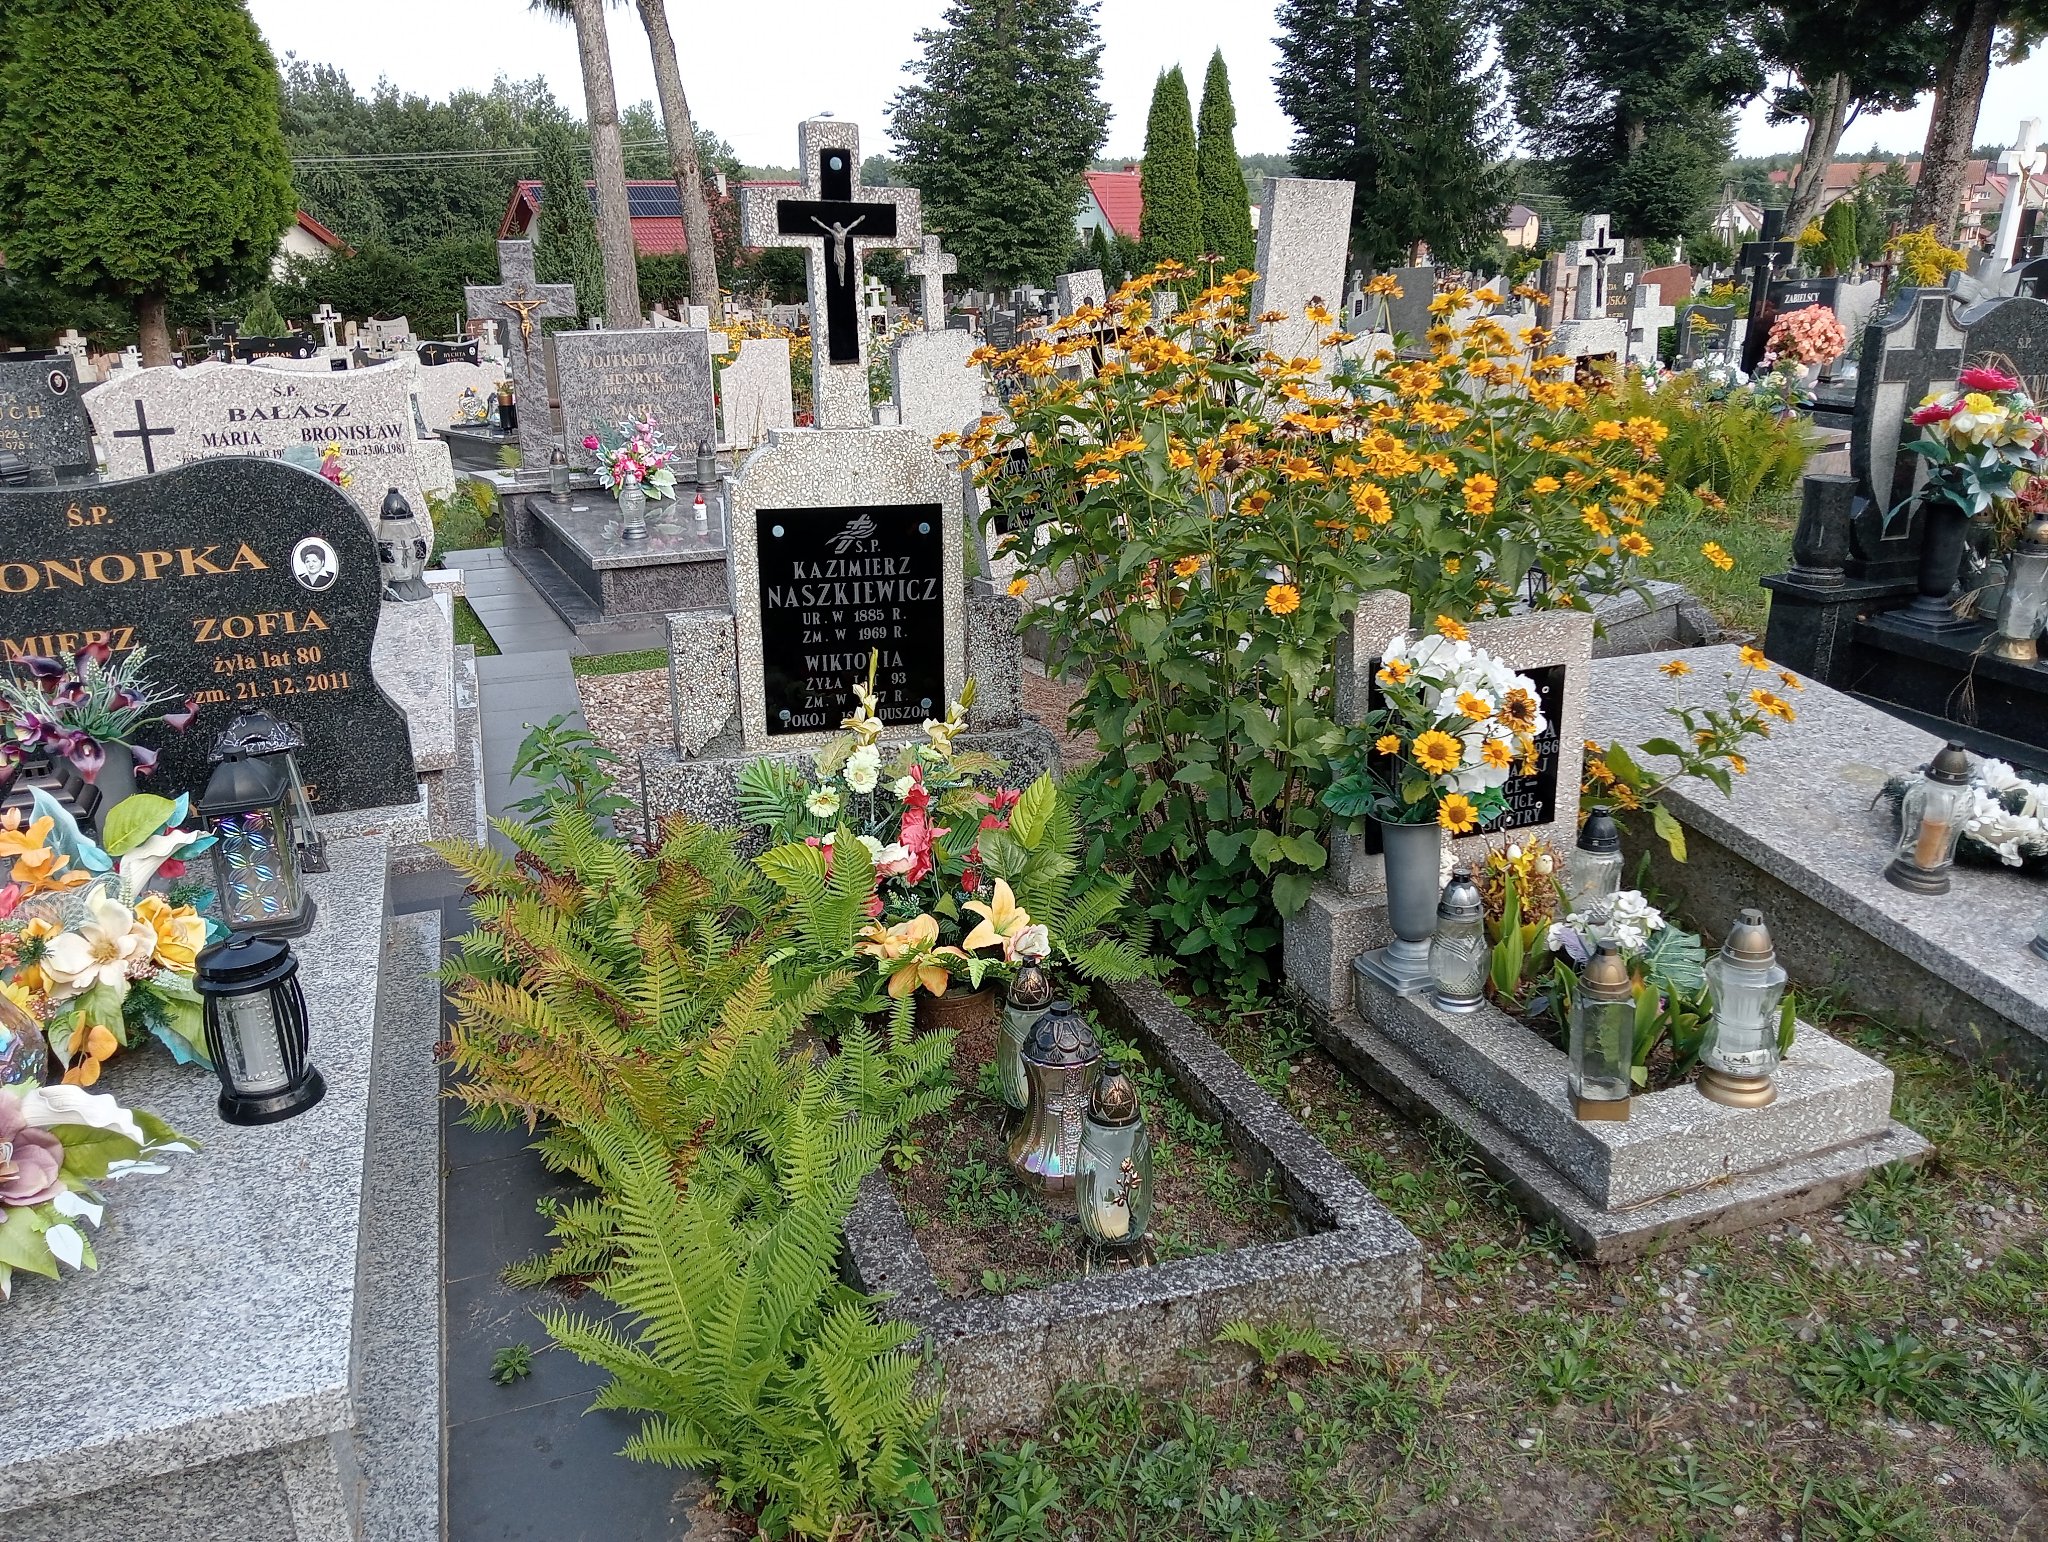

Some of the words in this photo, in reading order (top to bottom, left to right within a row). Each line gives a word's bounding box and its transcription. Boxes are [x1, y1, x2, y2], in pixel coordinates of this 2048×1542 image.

[1784, 292, 1820, 303] ZABIELSCY
[604, 372, 666, 385] HENRYK
[228, 403, 351, 422] BAŁASZ
[201, 431, 263, 448] MARIA
[301, 424, 402, 442] BRONISŁAW
[68, 502, 114, 527] Ś.P.
[793, 556, 911, 580] KAZIMIERZ
[767, 577, 938, 609] NASZKIEWICZ
[193, 609, 330, 643] ZOFIA
[832, 610, 844, 623] W
[854, 608, 885, 623] 1885
[835, 628, 847, 642] W
[859, 626, 887, 640] 1969
[213, 654, 257, 675] żyła
[263, 650, 291, 669] lat
[297, 645, 322, 665] 80
[804, 650, 904, 672] WIKTOIA
[193, 688, 231, 706] zm.
[307, 670, 350, 692] 2011
[891, 672, 907, 685] 93
[836, 693, 847, 707] W
